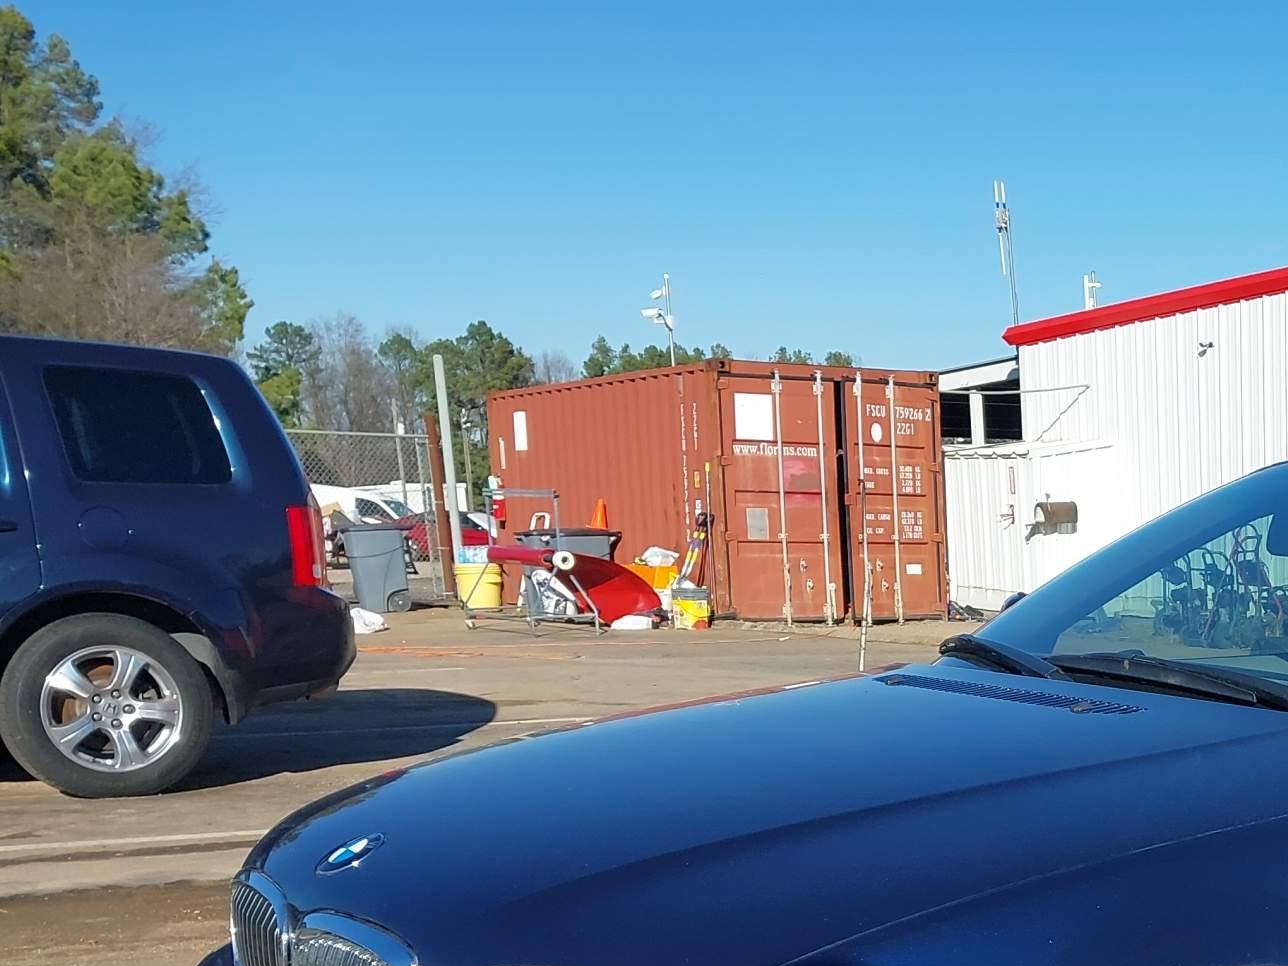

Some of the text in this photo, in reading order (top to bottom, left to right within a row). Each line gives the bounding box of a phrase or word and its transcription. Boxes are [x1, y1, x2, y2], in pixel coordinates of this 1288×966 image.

[865, 404, 886, 417] FSCU
[895, 406, 922, 420] 759266
[896, 423, 914, 435] 22G1
[732, 442, 817, 457] www.florns.com
